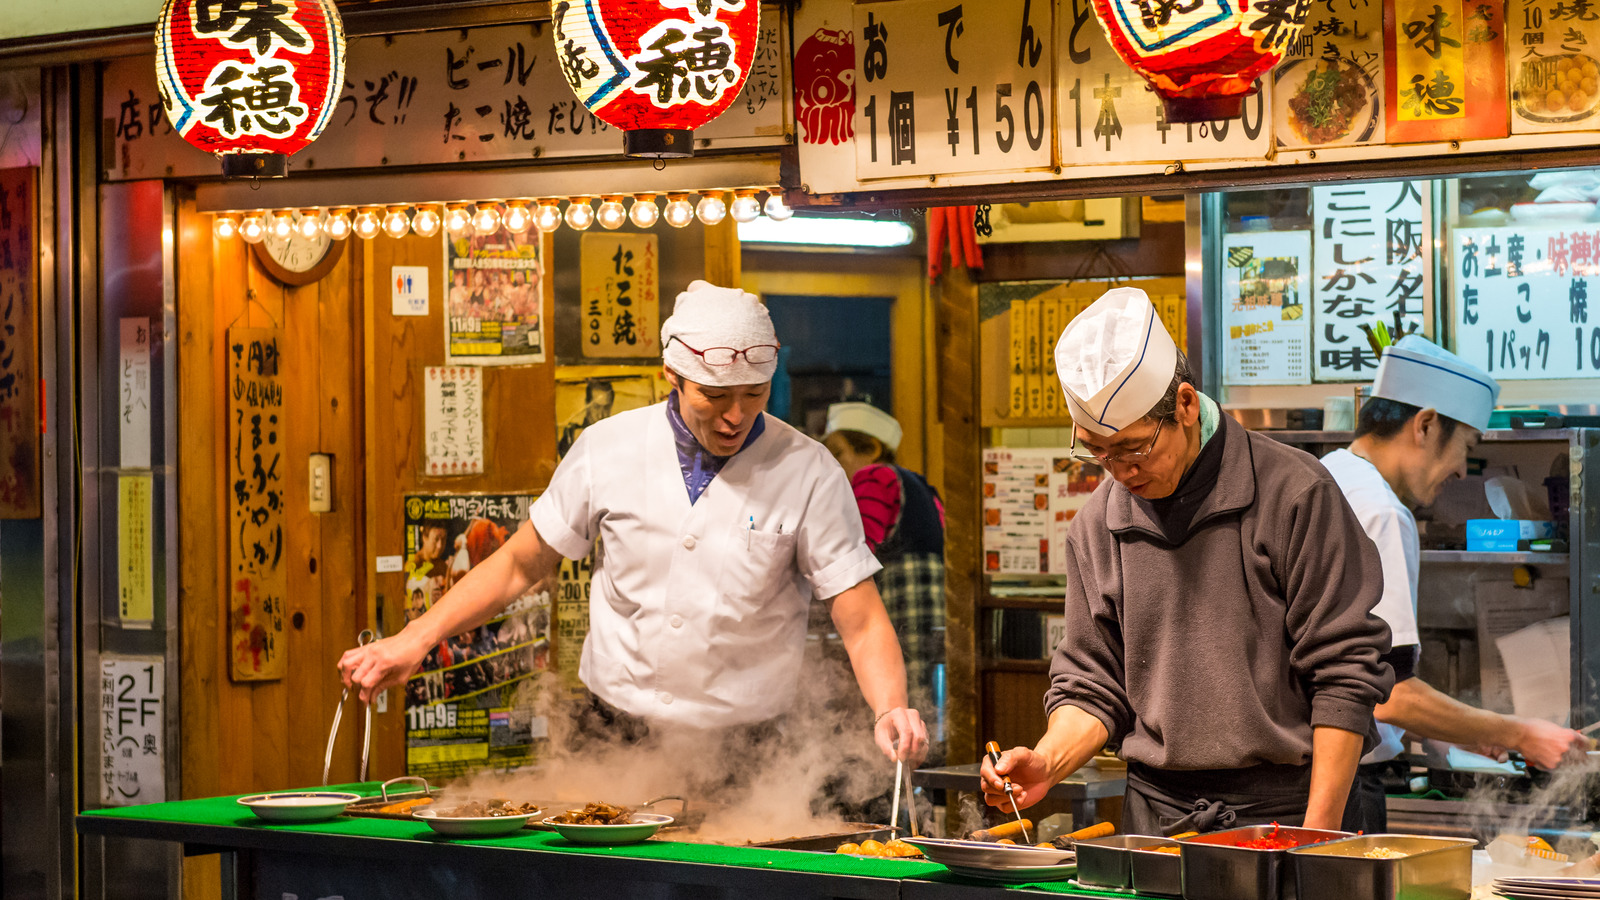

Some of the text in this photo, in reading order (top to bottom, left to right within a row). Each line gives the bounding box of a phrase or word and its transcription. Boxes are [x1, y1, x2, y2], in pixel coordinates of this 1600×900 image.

[445, 42, 538, 90] ビール
[635, 0, 742, 103] 穂
[767, 29, 778, 96] だいこん
[863, 4, 1042, 83] おでん
[1400, 5, 1464, 117] 味穂
[443, 95, 536, 144] たこ焼
[864, 80, 1045, 165] 1個 ¥150
[1070, 73, 1122, 151] 1本
[612, 244, 637, 346] たこ焼
[1385, 182, 1424, 340] 大阪名
[1463, 278, 1588, 325] たこ焼
[1486, 328, 1550, 372] 1パック
